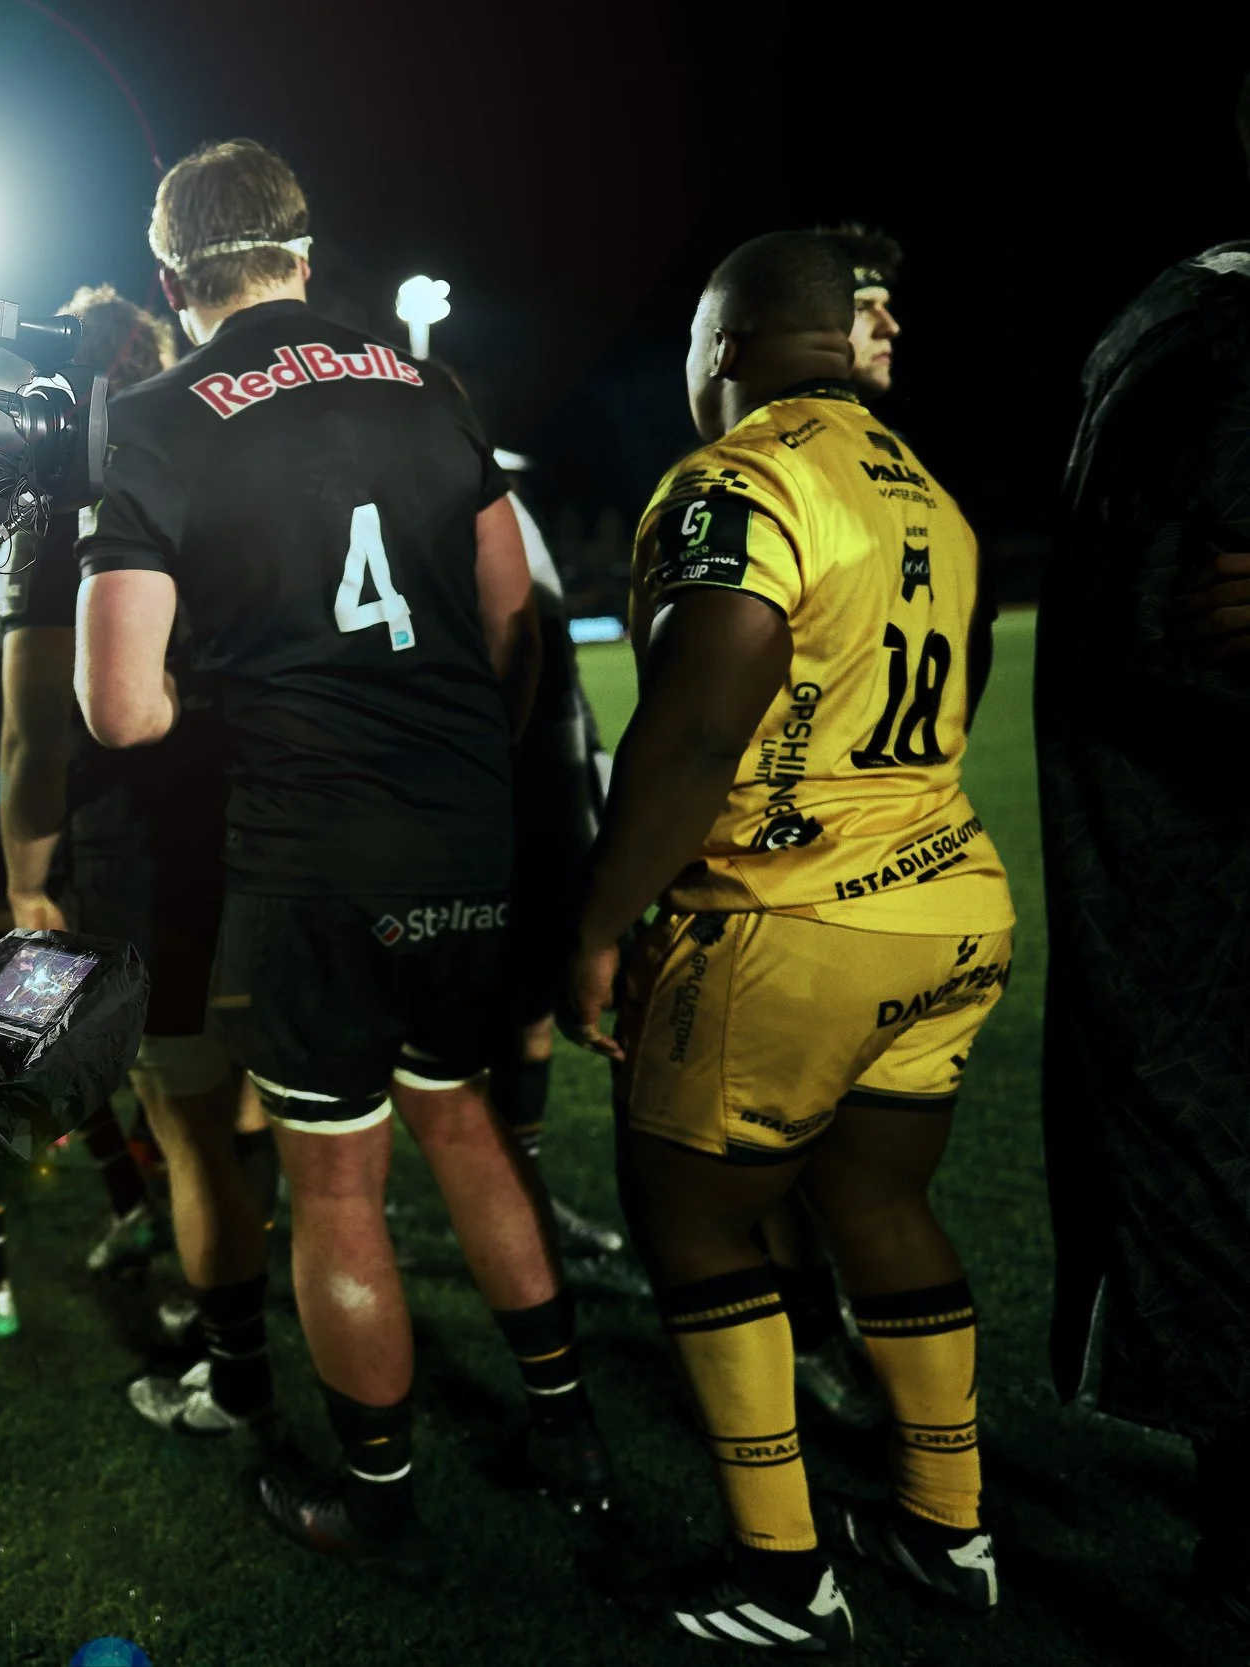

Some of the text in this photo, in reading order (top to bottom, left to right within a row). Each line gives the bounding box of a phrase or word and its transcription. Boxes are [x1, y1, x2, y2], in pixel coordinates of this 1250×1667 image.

[334, 502, 416, 651] 4
[681, 564, 709, 579] CUP
[850, 622, 951, 770] 18
